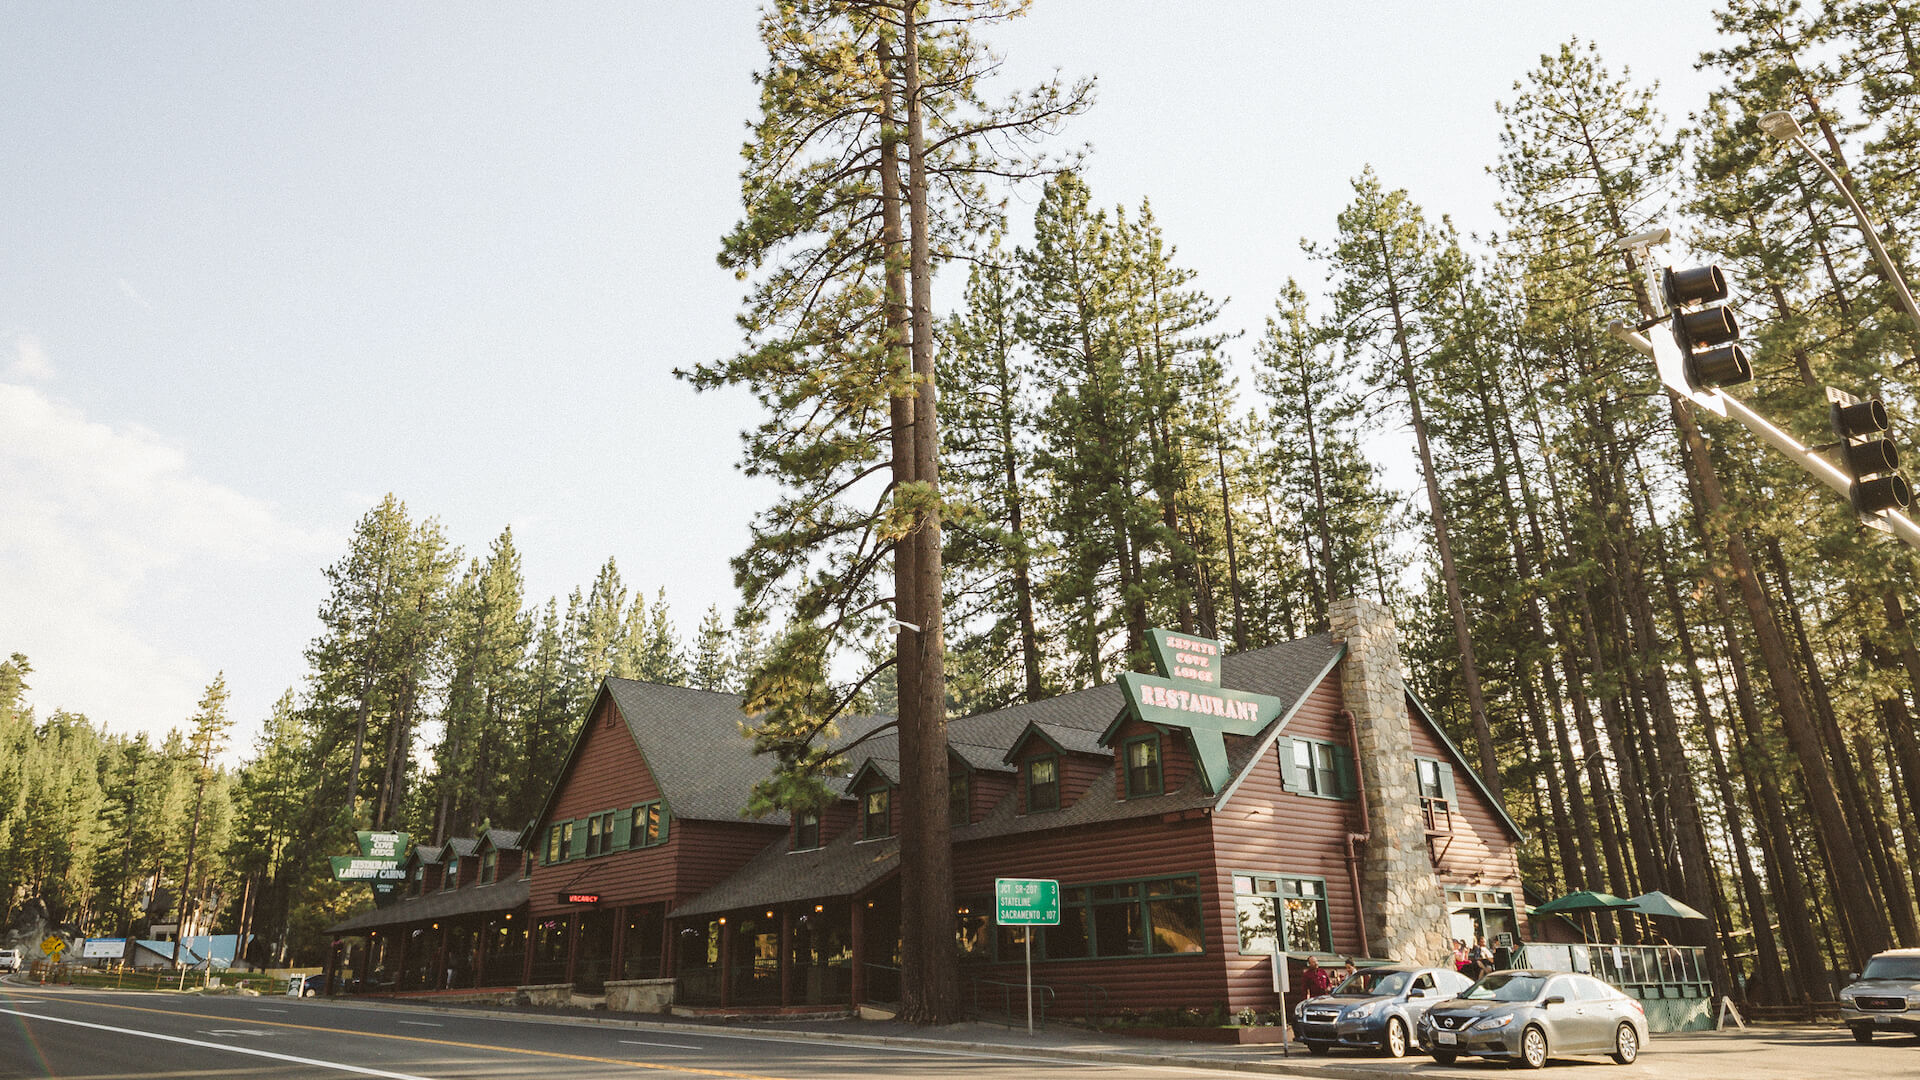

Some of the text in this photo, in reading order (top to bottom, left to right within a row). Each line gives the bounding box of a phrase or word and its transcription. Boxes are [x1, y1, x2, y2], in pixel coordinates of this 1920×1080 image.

[1166, 636, 1217, 656] ZEPHYR
[1175, 652, 1209, 668] COVE
[1173, 666, 1213, 682] LODGE
[1140, 685, 1258, 721] RESTAURANT
[351, 860, 398, 869] RESTAURANT
[339, 868, 378, 878] LAKEVIEW
[1000, 884, 1011, 895] JCT
[1051, 886, 1056, 895] 3
[1000, 897, 1056, 907] STATELINE 4
[1000, 910, 1041, 920] SACRAMENTO
